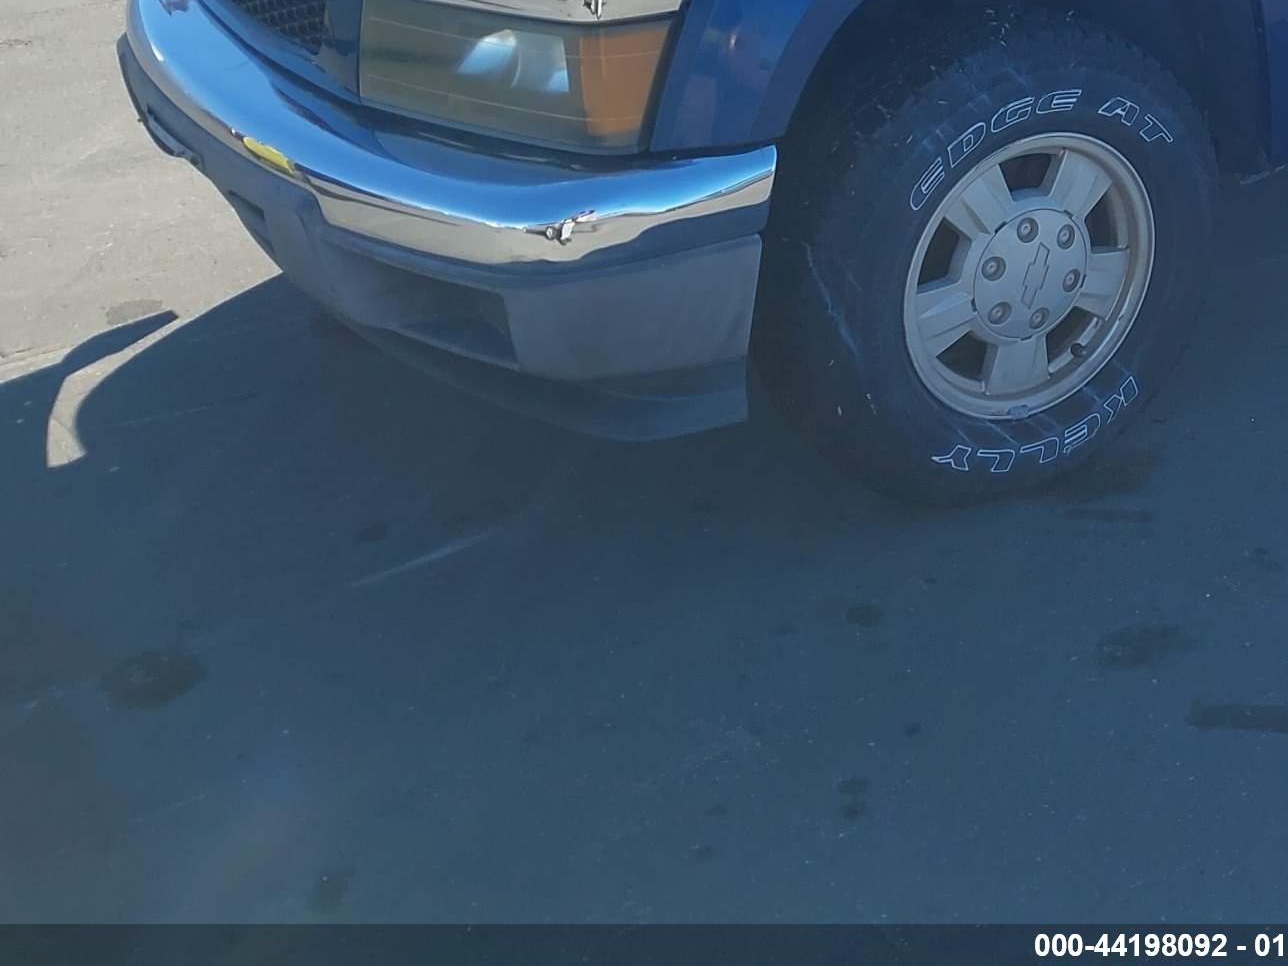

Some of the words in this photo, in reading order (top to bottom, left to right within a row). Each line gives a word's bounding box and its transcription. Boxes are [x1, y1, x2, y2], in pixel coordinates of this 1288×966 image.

[910, 89, 1083, 211] EDGE
[1098, 96, 1174, 143] AT
[931, 376, 1139, 473] KELLY
